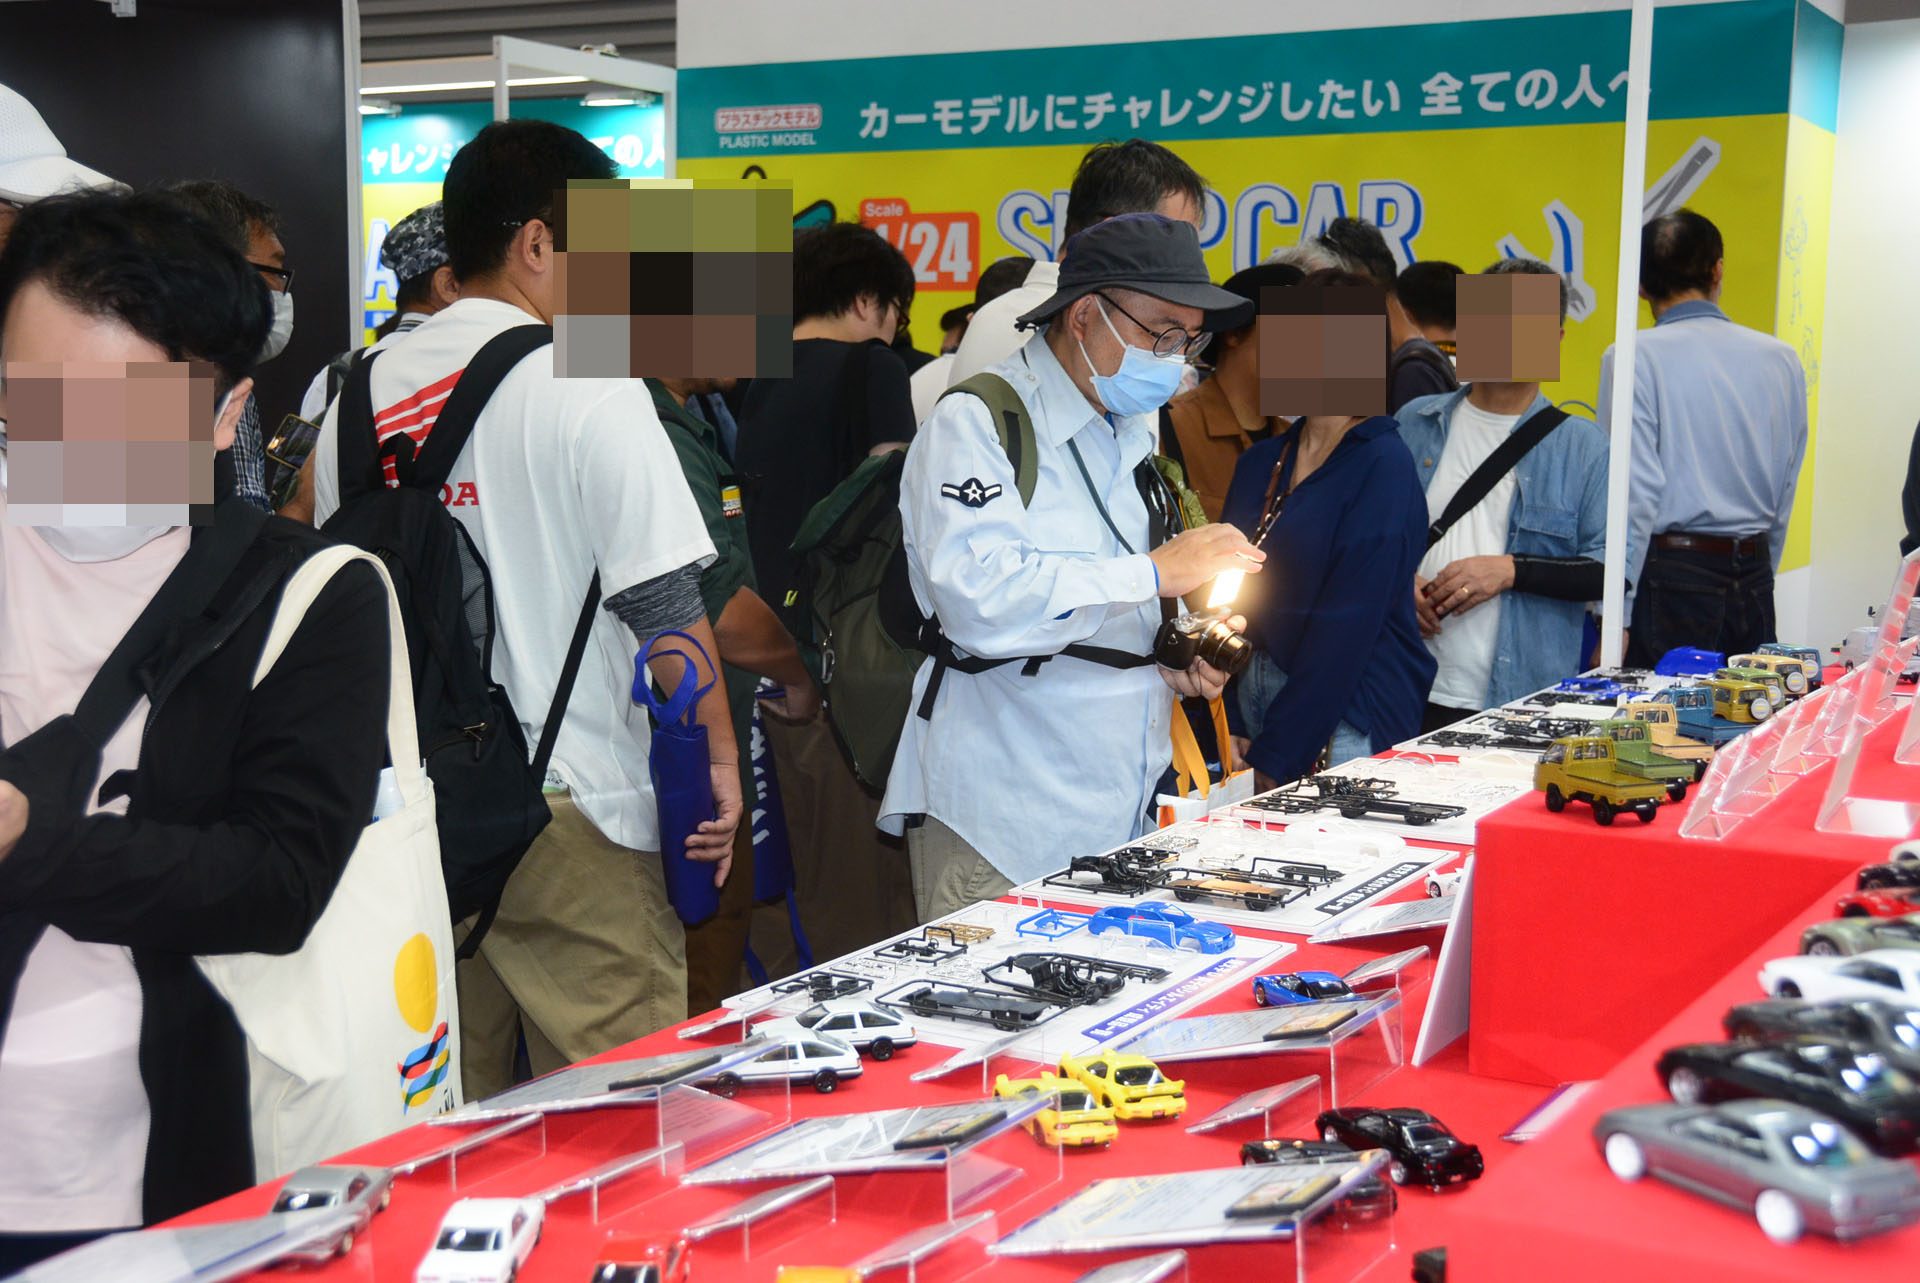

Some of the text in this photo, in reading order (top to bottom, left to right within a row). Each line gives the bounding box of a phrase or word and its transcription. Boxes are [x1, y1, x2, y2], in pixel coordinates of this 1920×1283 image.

[860, 79, 1401, 139] カーモデルにチャレンジしたい
[719, 109, 818, 129] プラスチックモデル
[720, 132, 817, 149] PLASTIC MODEL
[865, 202, 904, 217] Scale
